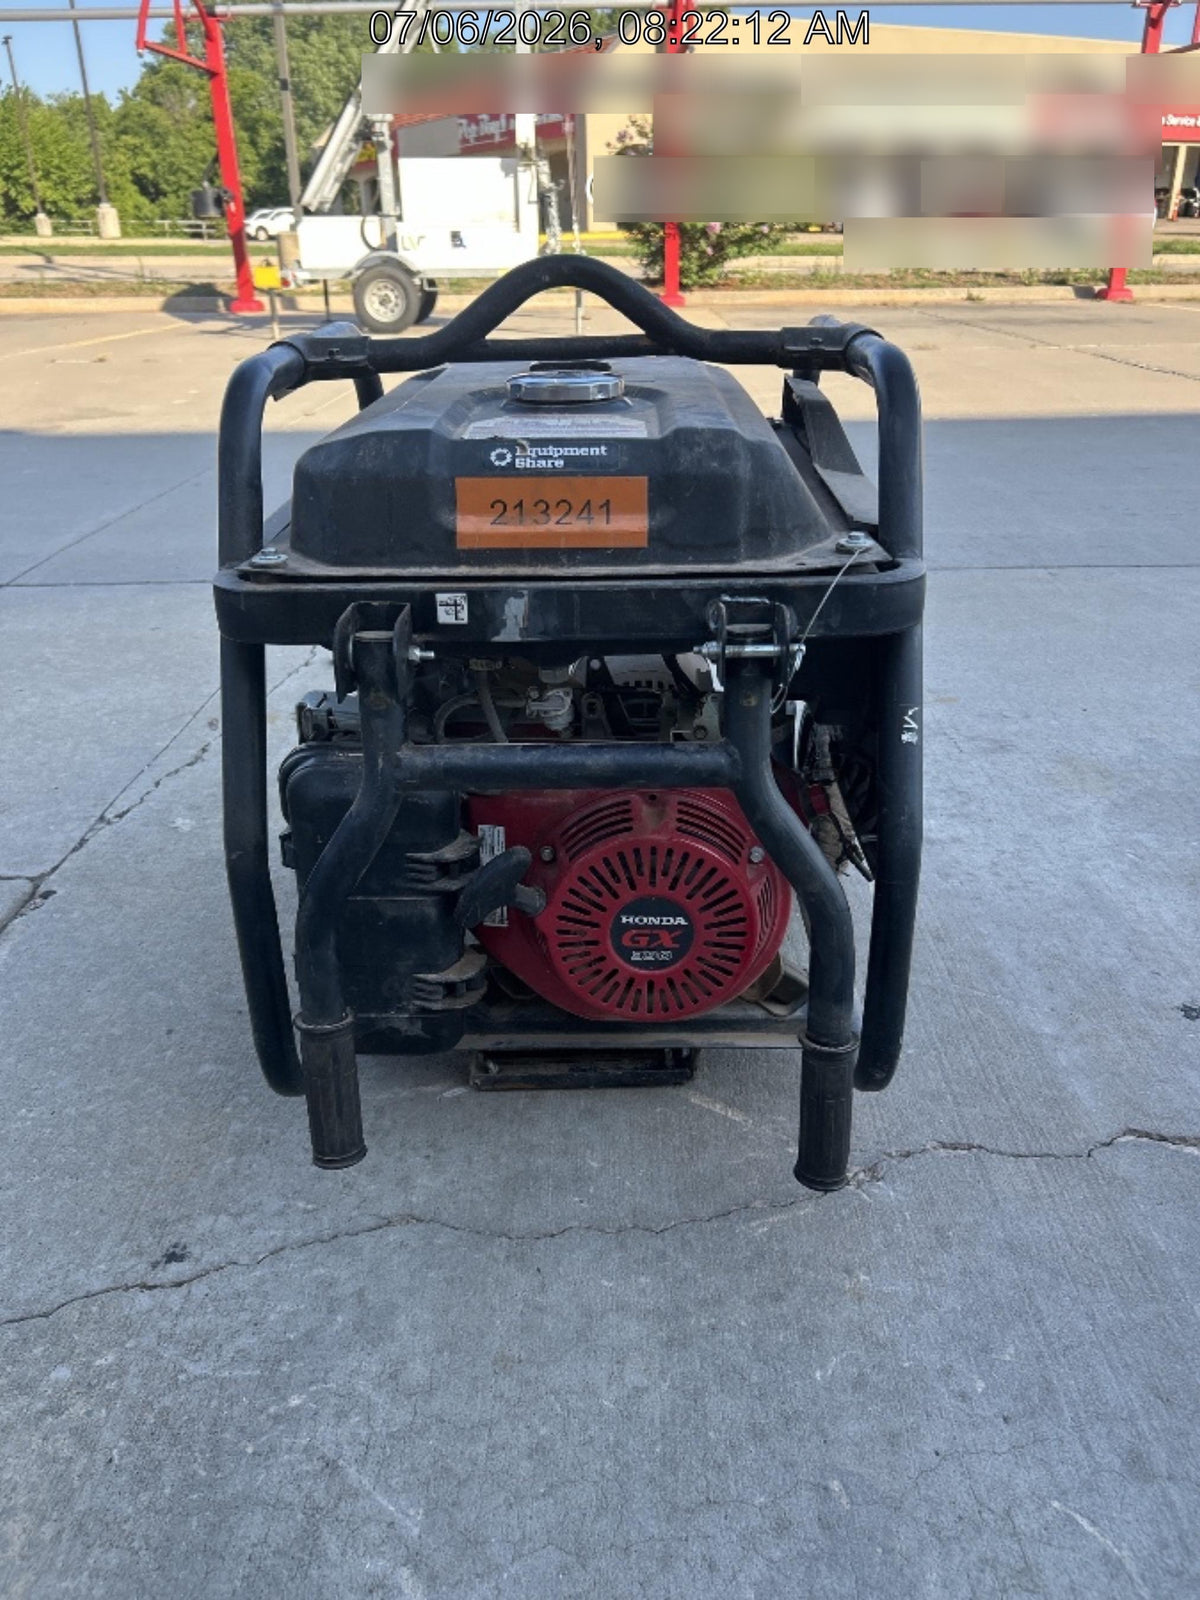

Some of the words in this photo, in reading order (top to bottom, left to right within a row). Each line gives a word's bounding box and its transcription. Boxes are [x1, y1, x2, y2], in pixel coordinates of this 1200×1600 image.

[515, 457, 565, 469] Share
[489, 498, 612, 526] 213241
[620, 914, 689, 926] HONDA
[622, 928, 683, 949] GX
